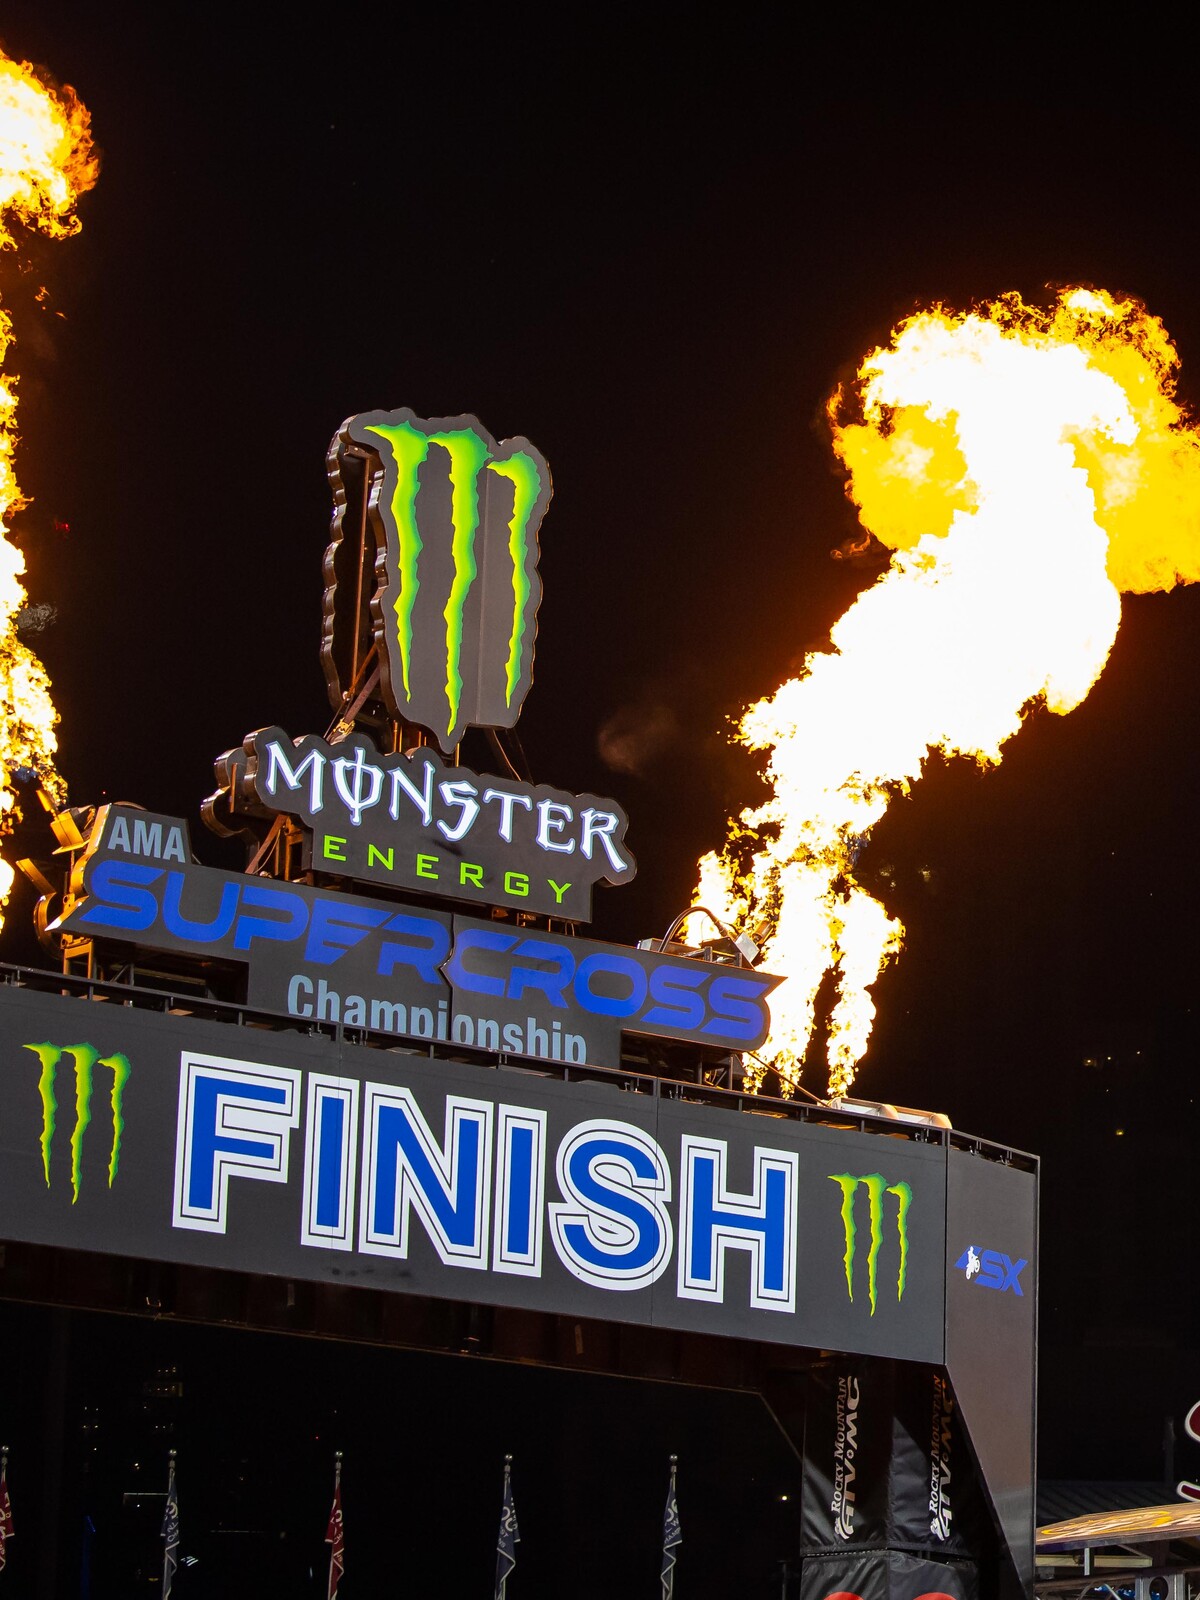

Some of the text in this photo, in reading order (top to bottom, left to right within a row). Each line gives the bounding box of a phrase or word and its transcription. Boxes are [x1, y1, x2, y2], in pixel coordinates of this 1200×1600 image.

[107, 815, 186, 864] AMA
[264, 739, 628, 874] MONSTER
[322, 834, 573, 905] ENERGY
[79, 859, 770, 1041] SUPERCROSS
[287, 974, 588, 1065] Championship
[172, 1051, 799, 1314] FINISH
[831, 1376, 847, 1513] ROCKY MOUNTAIN
[929, 1374, 942, 1514] ROCKY MOUNTAIN
